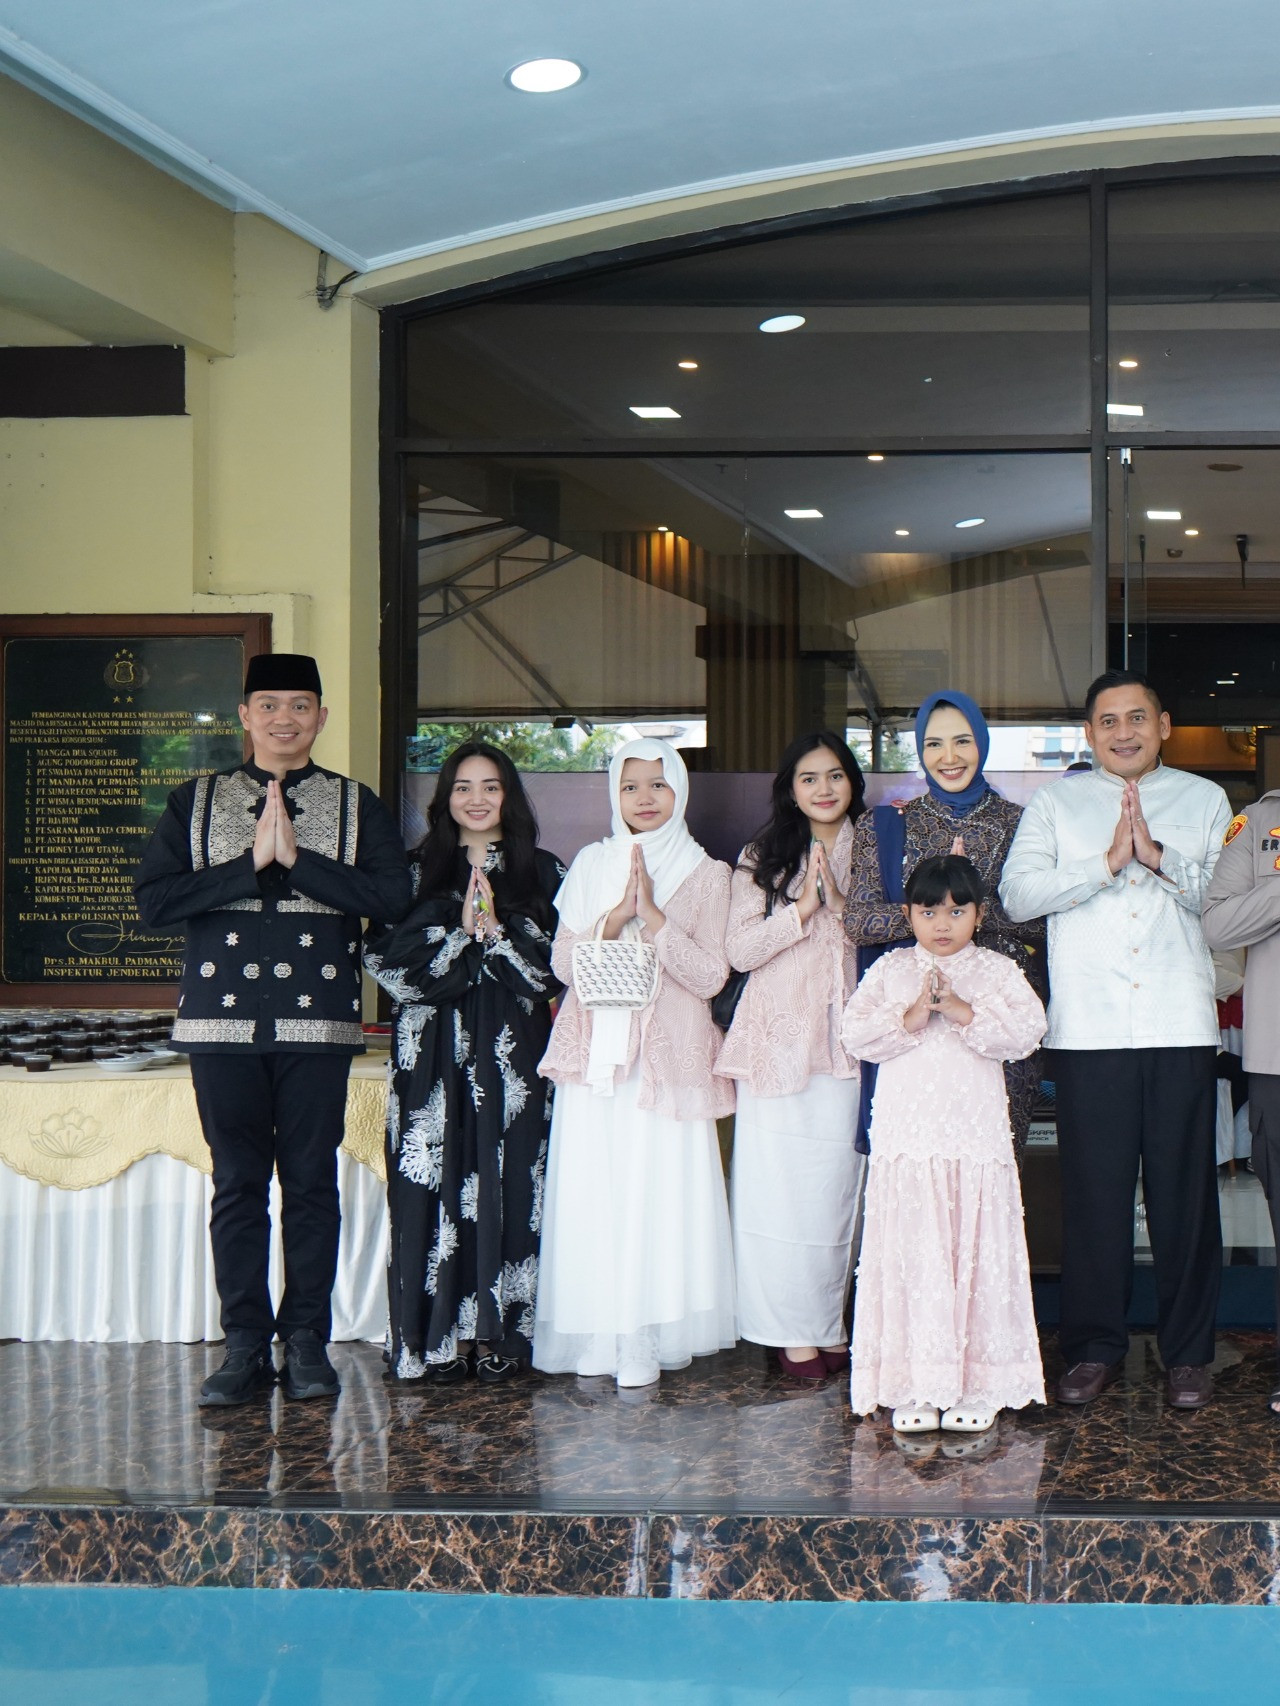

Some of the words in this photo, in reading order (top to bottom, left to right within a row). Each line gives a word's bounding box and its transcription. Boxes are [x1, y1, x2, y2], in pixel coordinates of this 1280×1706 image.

[36, 749, 71, 757] MANGGA
[72, 749, 87, 757] DUA
[88, 749, 118, 758] SQUARE
[37, 758, 63, 766] AGUNG
[65, 758, 107, 766] PODOMORO
[110, 758, 139, 766] GROUP
[48, 768, 83, 776] SWADAYA
[49, 778, 94, 786] MANDARA
[47, 836, 72, 844] ASTRA
[74, 836, 101, 844] MOTOR
[35, 876, 58, 884] IRJEN
[101, 876, 136, 884] MAKBUL
[19, 913, 58, 921] KEPALA
[61, 913, 120, 921] KEPOLISIAN
[125, 957, 184, 965] PADMANAG
[44, 968, 103, 976] INSPEKTUR
[107, 968, 163, 976] JENDERAL
